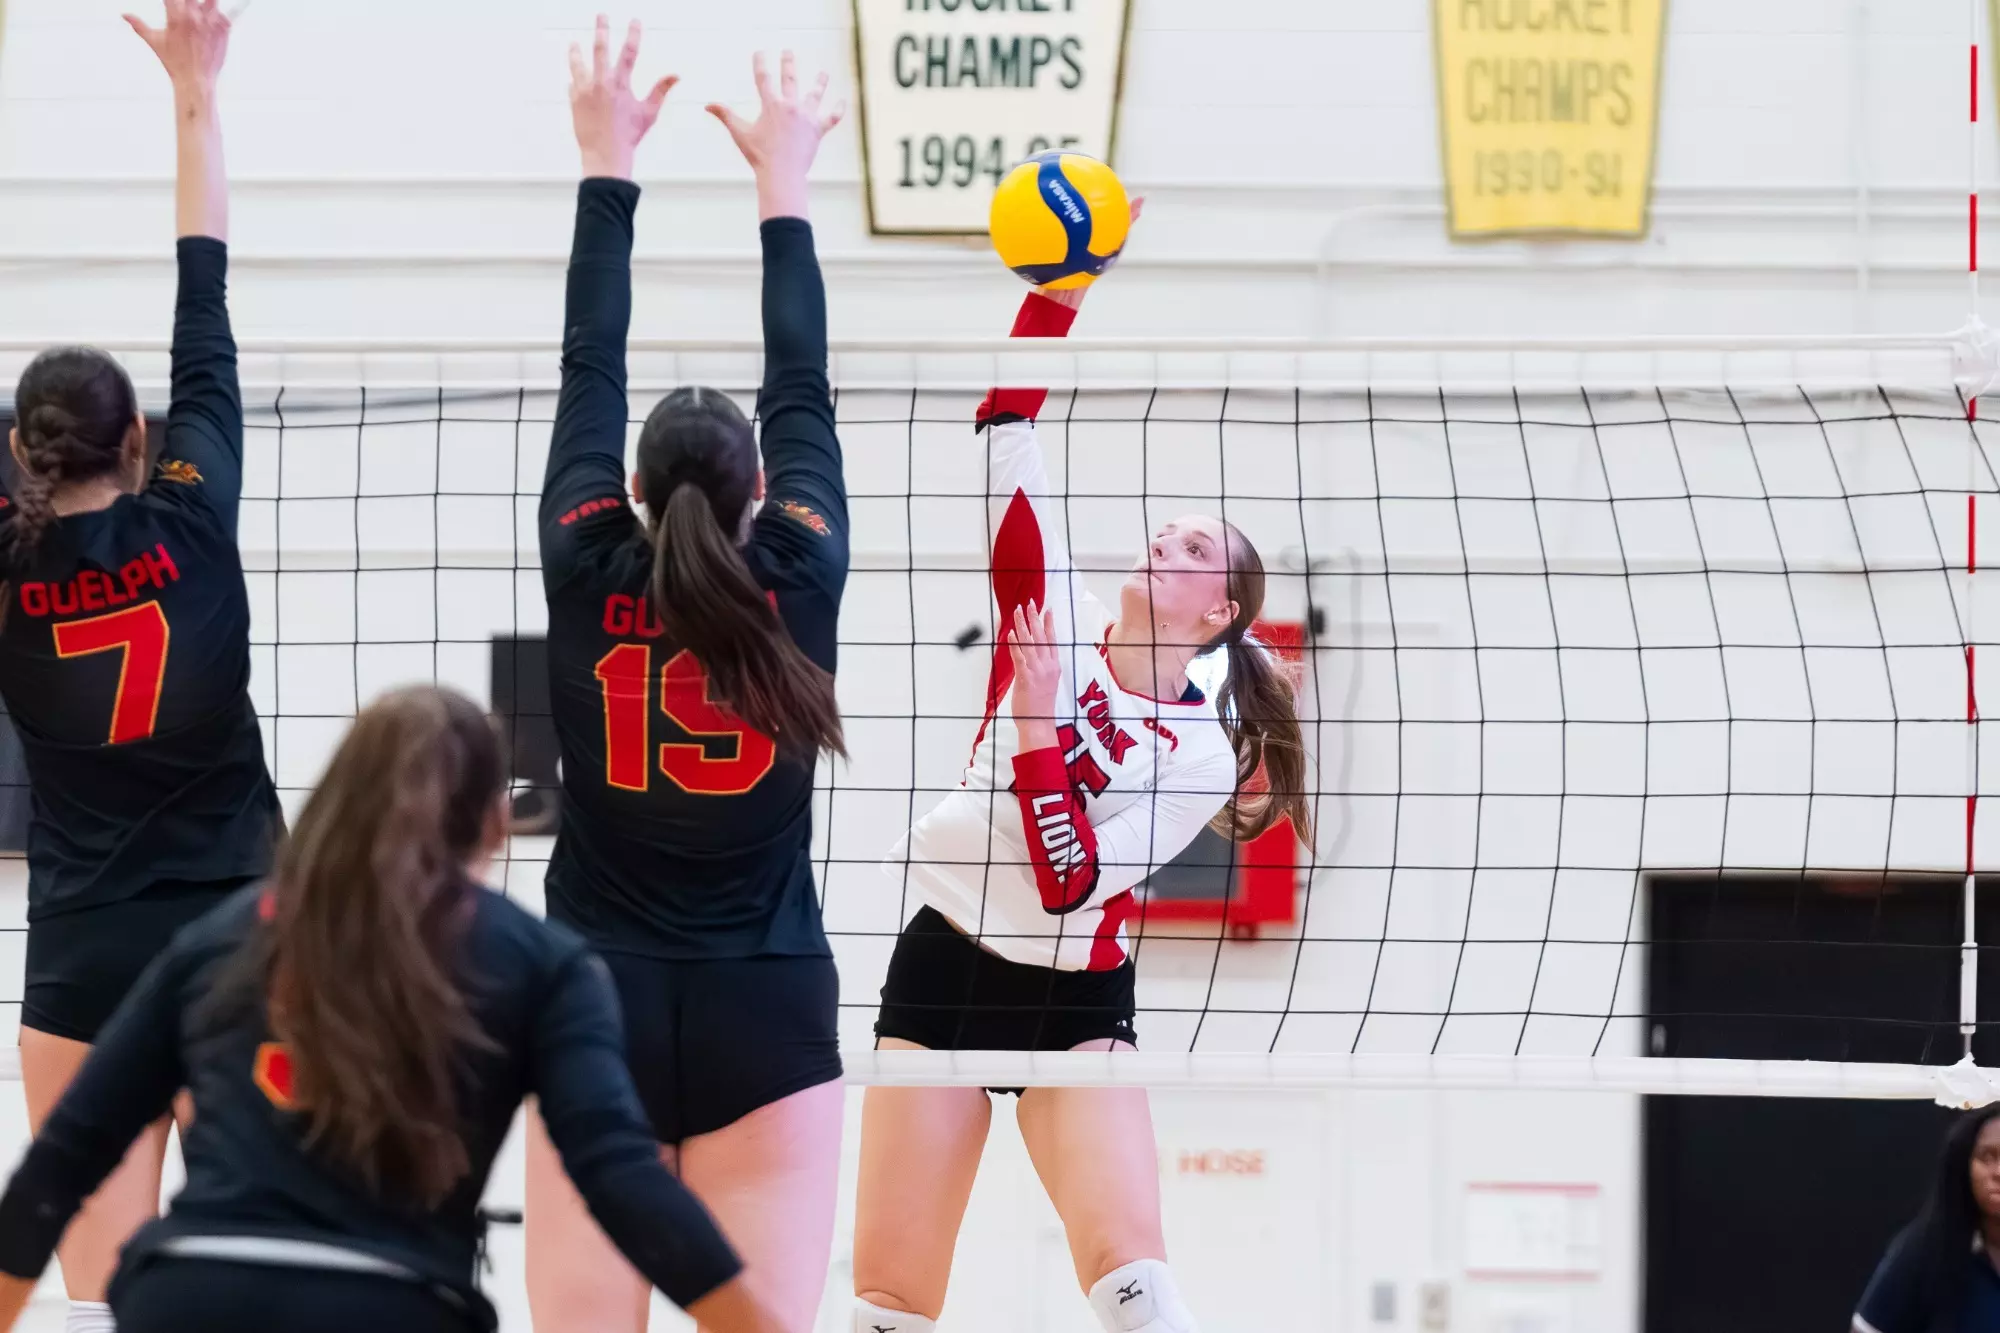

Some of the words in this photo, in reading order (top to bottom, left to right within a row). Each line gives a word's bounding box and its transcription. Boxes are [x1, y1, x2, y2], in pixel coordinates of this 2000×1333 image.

[893, 34, 1085, 90] CHAMPS
[1464, 56, 1636, 127] CHAMPS
[895, 135, 1080, 188] 1994-
[19, 542, 181, 617] GUELPH
[52, 599, 170, 745] 7
[1077, 677, 1139, 766] YORK
